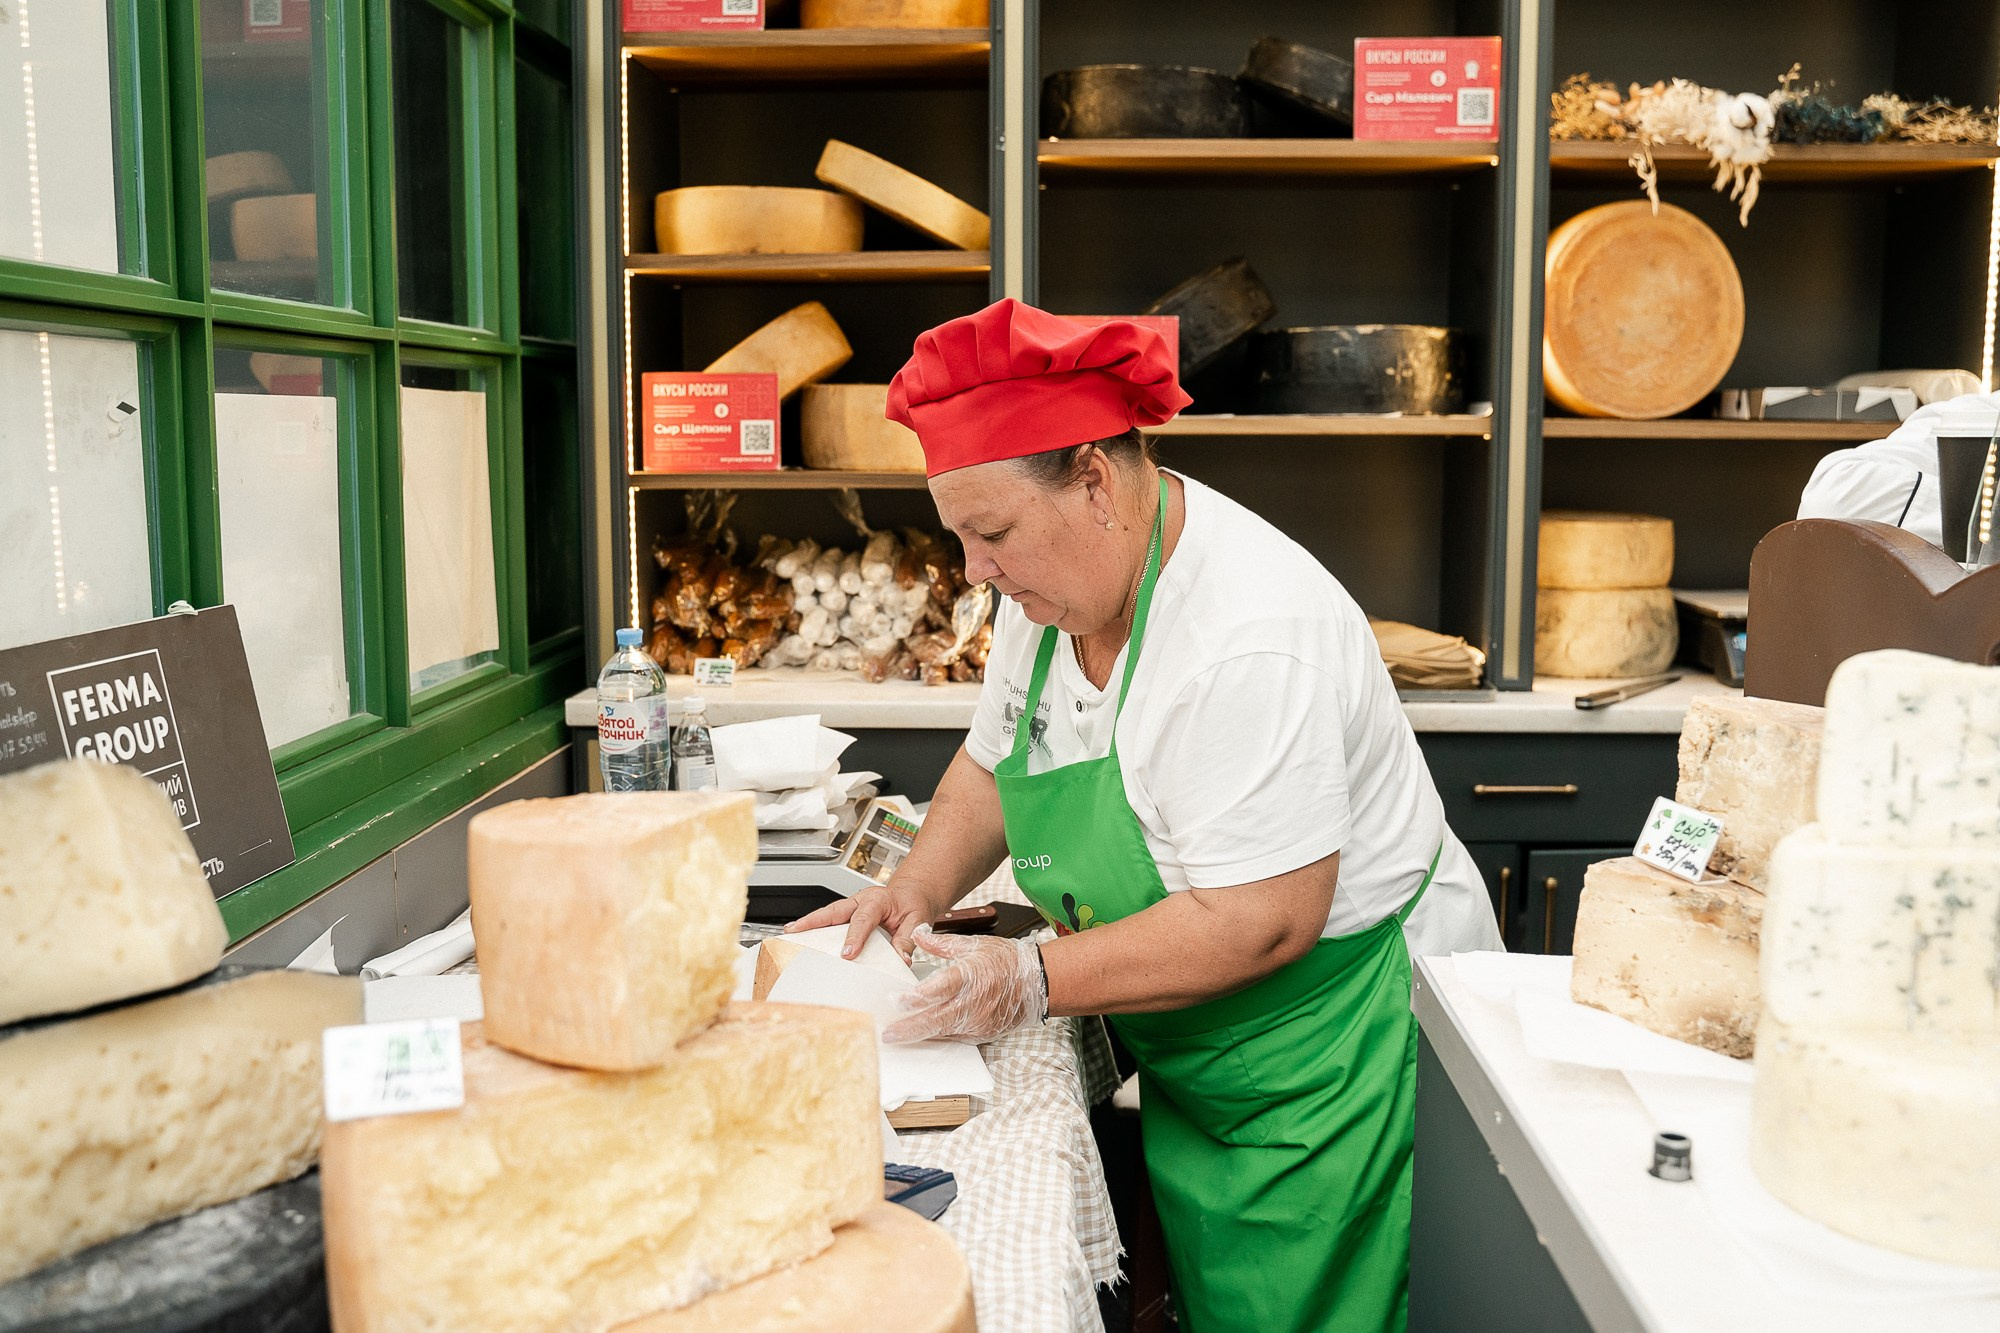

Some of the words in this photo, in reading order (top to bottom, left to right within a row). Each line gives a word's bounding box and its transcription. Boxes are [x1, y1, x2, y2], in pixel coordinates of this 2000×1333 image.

[653, 383, 686, 397] ВКУСЫ
[688, 383, 728, 397] РОССИИ
[62, 672, 162, 726] FERMA
[75, 716, 169, 764] GROUP
